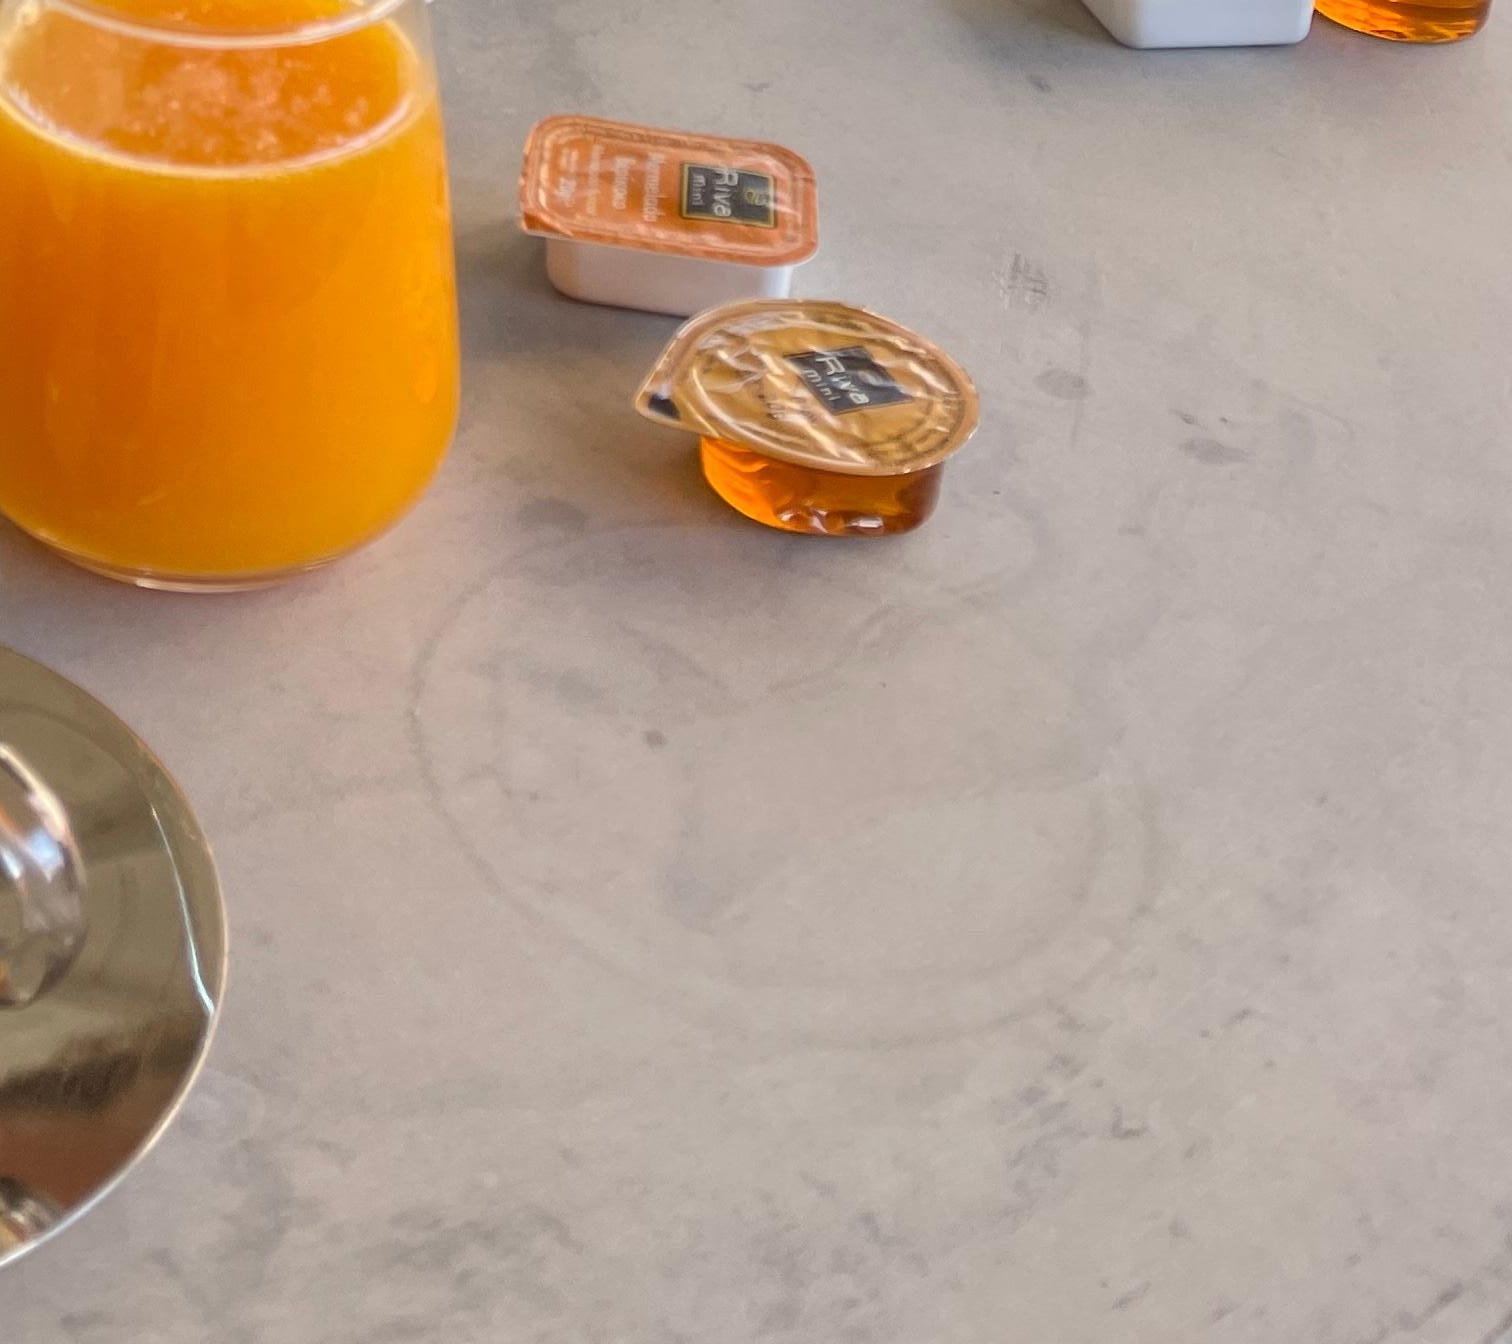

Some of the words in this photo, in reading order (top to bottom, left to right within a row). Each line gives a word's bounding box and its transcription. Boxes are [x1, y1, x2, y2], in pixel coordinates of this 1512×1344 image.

[691, 173, 706, 206] mini
[712, 169, 739, 217] Riva
[804, 369, 841, 401] mini
[816, 356, 870, 405] Riva
